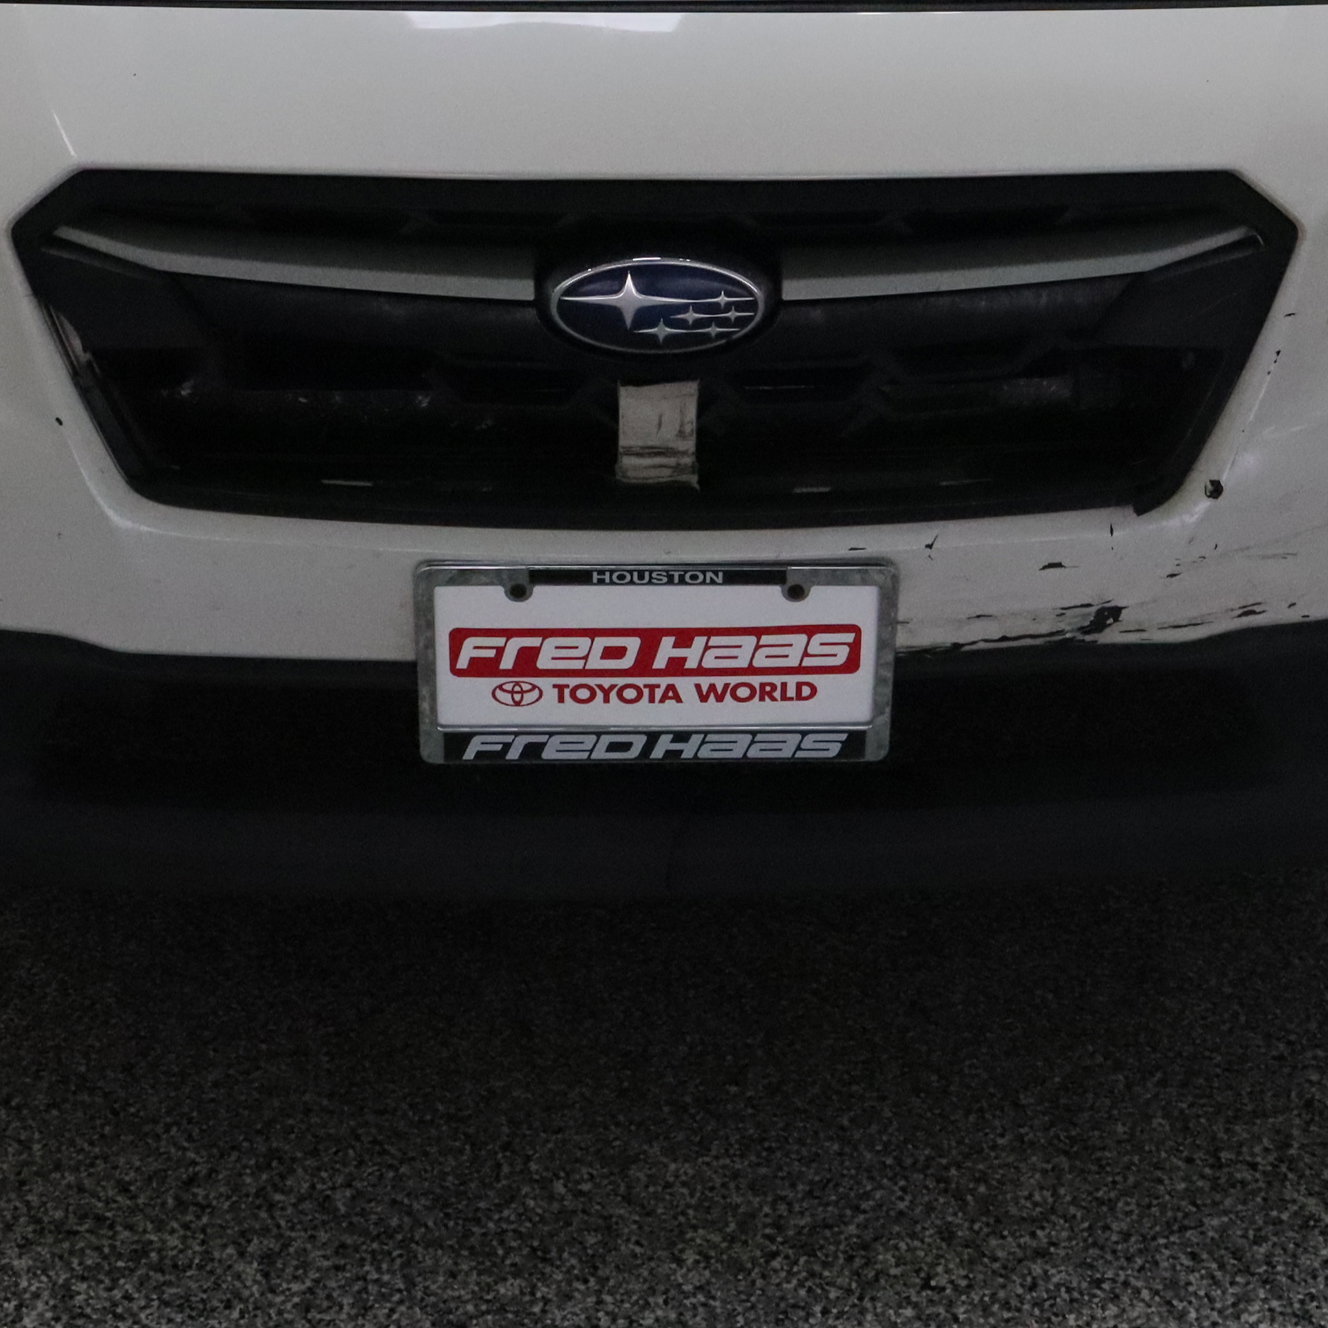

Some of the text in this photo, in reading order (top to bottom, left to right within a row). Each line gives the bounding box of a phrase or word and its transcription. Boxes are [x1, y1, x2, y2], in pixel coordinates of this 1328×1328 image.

[591, 570, 724, 584] HOUSTON
[552, 681, 818, 705] TOYOTA WORLD
